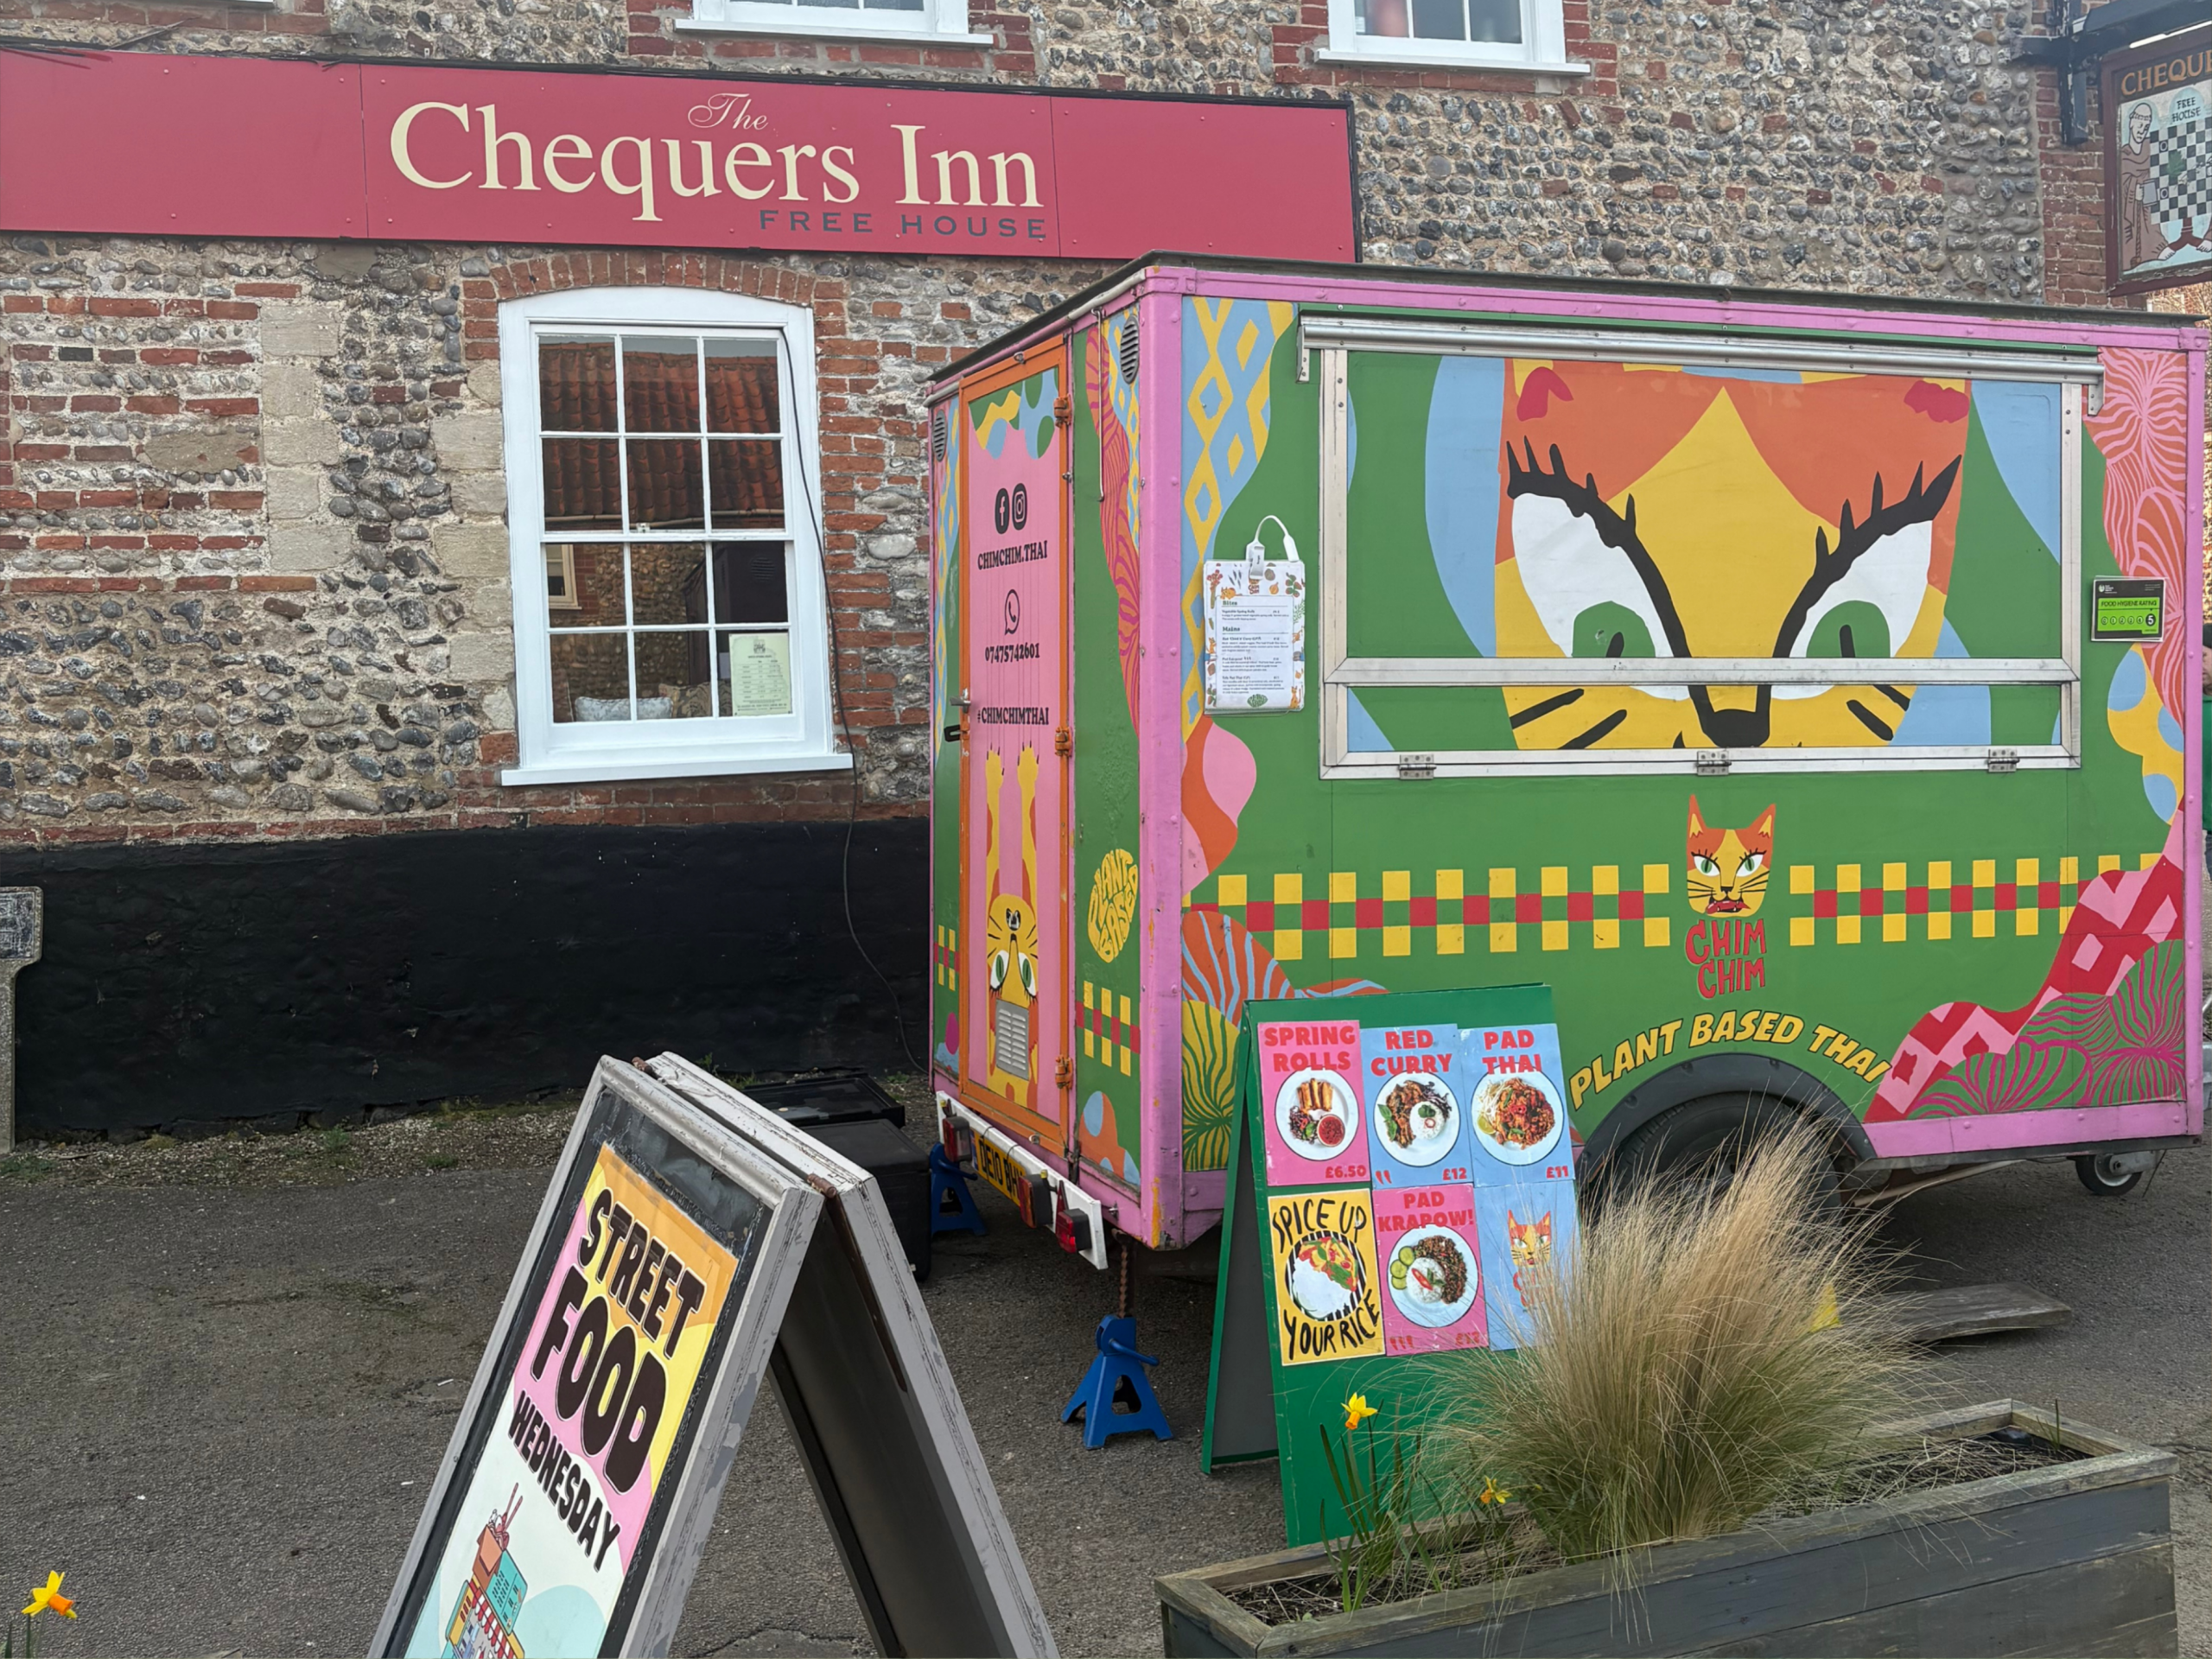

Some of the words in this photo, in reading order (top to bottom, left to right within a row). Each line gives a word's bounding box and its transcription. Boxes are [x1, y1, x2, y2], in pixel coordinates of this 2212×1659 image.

[688, 92, 768, 131] The
[2171, 106, 2202, 123] HOUSE
[2177, 97, 2196, 110] FREE
[391, 101, 861, 222] Chequers
[890, 124, 1044, 207] Inn
[760, 209, 873, 233] FREE
[901, 215, 1047, 239] HOUSE
[977, 540, 1048, 570] CHIMCHIM.THAI
[2147, 614, 2154, 625] 5
[985, 642, 1040, 664] 07475742601
[976, 706, 1050, 726] #CHIMCHIMTHAI
[1685, 918, 1767, 965] CHIM
[1697, 957, 1766, 999] CHIM
[1264, 1026, 1356, 1047] SPRING
[1385, 1029, 1434, 1051] RED
[1483, 1029, 1535, 1051] PAD
[1273, 1051, 1352, 1072] ROLLS
[1370, 1052, 1453, 1077] CURRY
[1482, 1054, 1542, 1076] THAI
[1568, 1018, 1683, 1112] PLANT
[1688, 1009, 1804, 1049] BASED
[1807, 1023, 1893, 1084] THAI
[1003, 1158, 1023, 1198] BH
[1325, 1164, 1368, 1179] £6.50
[1442, 1166, 1468, 1181] £12
[1546, 1165, 1569, 1179] £11
[1403, 1191, 1446, 1210] PAD
[1271, 1198, 1336, 1254] SPICE
[1338, 1200, 1368, 1244] UP
[1378, 1209, 1474, 1233] KRAPOW!
[577, 1188, 707, 1360] STREET
[1282, 1308, 1338, 1361] YOUR
[1340, 1289, 1381, 1349] RICE
[530, 1265, 667, 1495] FOOD
[507, 1389, 620, 1573] WEDNESDAY
